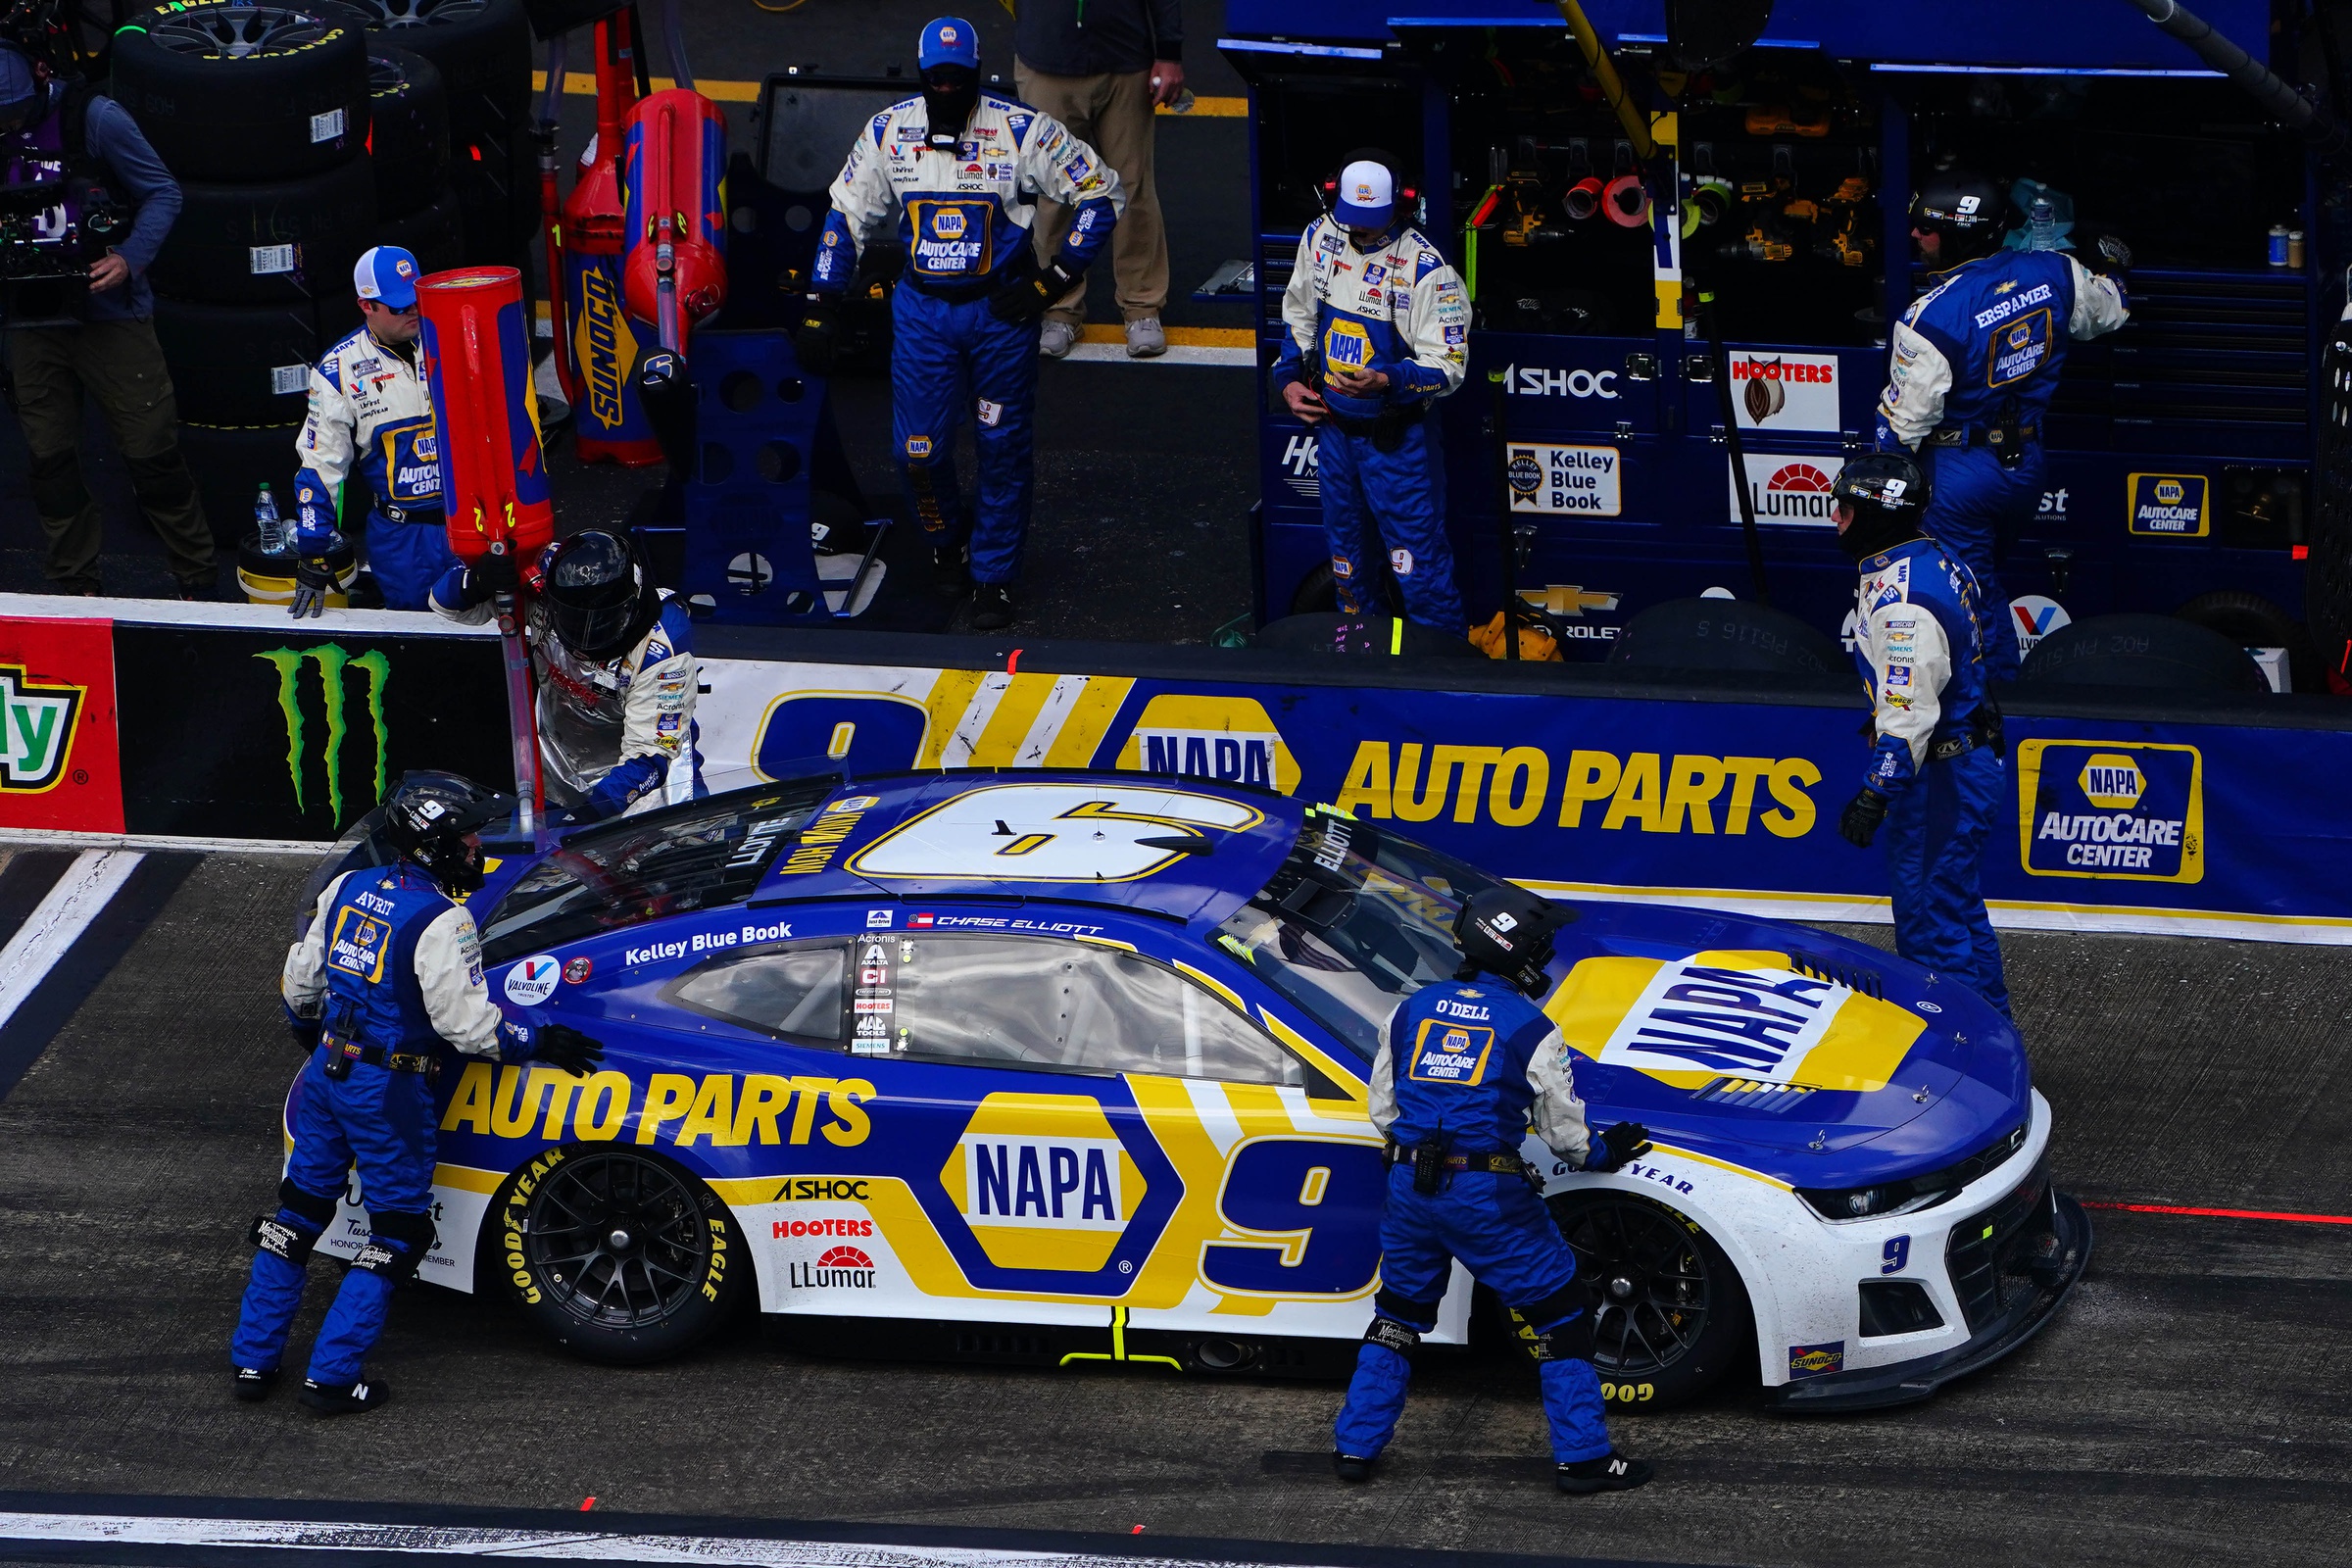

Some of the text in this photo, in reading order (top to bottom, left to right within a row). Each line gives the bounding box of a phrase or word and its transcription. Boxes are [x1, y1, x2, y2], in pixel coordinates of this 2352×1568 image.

[1957, 195, 1982, 215] 9
[937, 216, 963, 231] NAPA
[1410, 231, 1430, 250] NAPA
[927, 255, 966, 270] CENTER
[1975, 283, 2053, 329] ERSPAMER
[332, 339, 358, 355] NAPA
[1328, 329, 1364, 367] NAPA
[2011, 328, 2030, 346] NAPA
[584, 275, 625, 424] SUNOCO
[1996, 343, 2046, 372] AUTOCARE
[1732, 361, 1834, 384] HOOTERS
[2006, 359, 2036, 379] CENTER
[416, 435, 437, 456] NAP
[910, 441, 928, 453] NAPA
[1550, 450, 1614, 474] Kelley
[1550, 470, 1597, 490] Blue
[1882, 478, 1908, 499] 9
[1551, 491, 1603, 511] Book
[2159, 485, 2180, 499] NAPA
[2137, 505, 2199, 521] AUTOCARE
[2149, 520, 2185, 531] CENTER
[1390, 547, 1414, 576] 9
[1334, 740, 1824, 840] AUTO PARTS
[2089, 767, 2138, 796] NAPA
[417, 799, 446, 821] 9
[845, 783, 1268, 883] 9
[2037, 810, 2184, 847] AUTOCARE
[1313, 818, 1352, 872] ELLIOTT
[2066, 843, 2154, 869] CENTER
[779, 845, 840, 876] HOW
[355, 891, 396, 917] AVRIT
[936, 915, 1104, 936] CHASE ELLIOTT
[1491, 911, 1518, 933] 9
[625, 921, 793, 967] Kelley Blue Book
[857, 933, 896, 944] Acronis
[507, 978, 551, 997] VALVOLINE
[856, 1003, 891, 1011] HOOTERS
[1436, 999, 1491, 1022] O'DELL
[1626, 965, 1838, 1075] NAPA
[856, 1042, 886, 1051] SIEMENS
[1446, 1034, 1469, 1050] NAPA
[1420, 1052, 1477, 1070] AUTOCARE
[1427, 1065, 1461, 1080] CENTER
[440, 1060, 878, 1148] AUTO PARTS
[772, 1177, 870, 1202] ASHOC
[974, 1142, 1118, 1223] NAPA
[507, 1145, 566, 1308] GOODYEAR
[771, 1218, 874, 1240] HOOTERS
[1198, 1134, 1386, 1303] 9
[700, 1216, 727, 1311] EAGLE
[1882, 1231, 1912, 1277] 9
[789, 1261, 877, 1291] LLumar
[1791, 1351, 1843, 1370] SUNOCO
[352, 1382, 369, 1400] N
